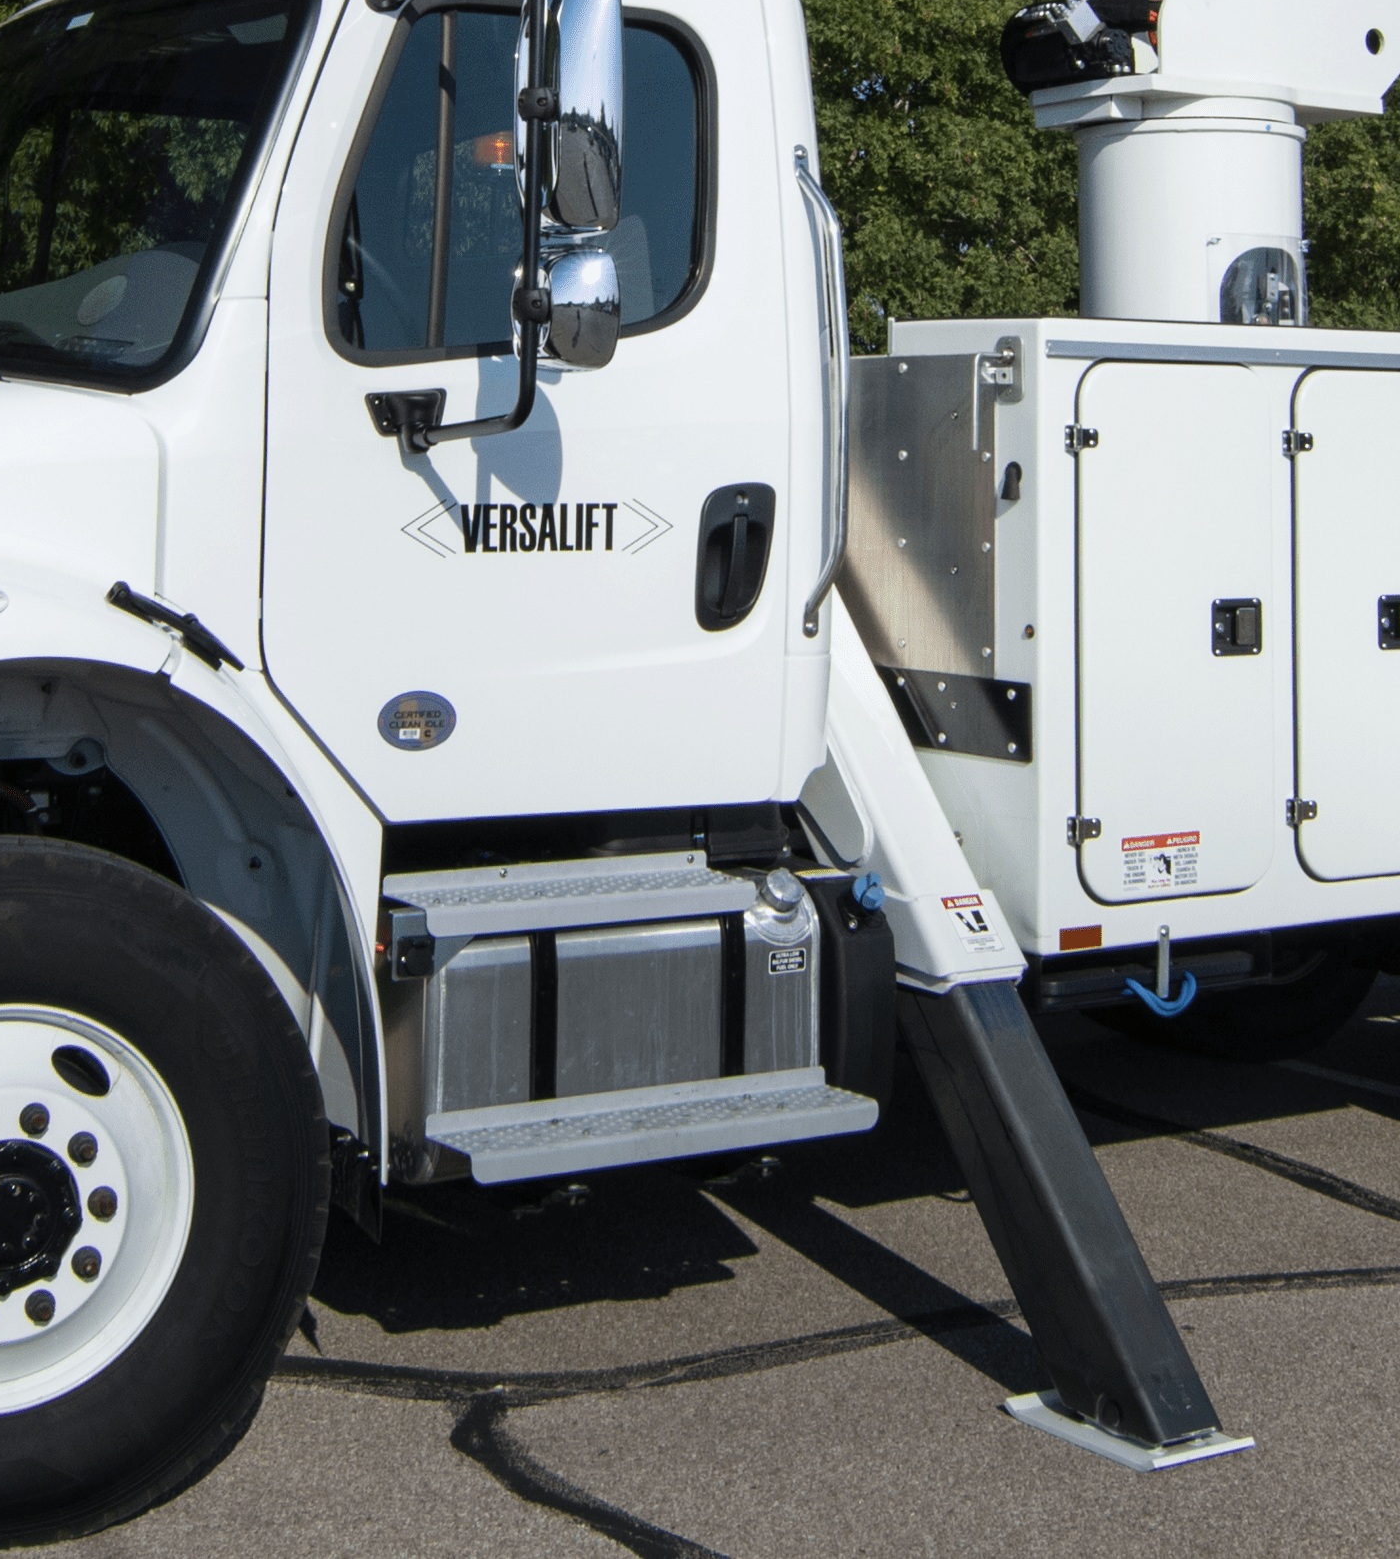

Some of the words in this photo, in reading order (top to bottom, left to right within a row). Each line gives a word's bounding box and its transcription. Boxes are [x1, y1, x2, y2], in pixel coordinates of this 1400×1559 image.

[461, 503, 618, 553] VERSALIFT
[394, 710, 441, 719] CERTIFIED
[389, 720, 421, 729] CLEAN
[425, 720, 445, 728] IDLE
